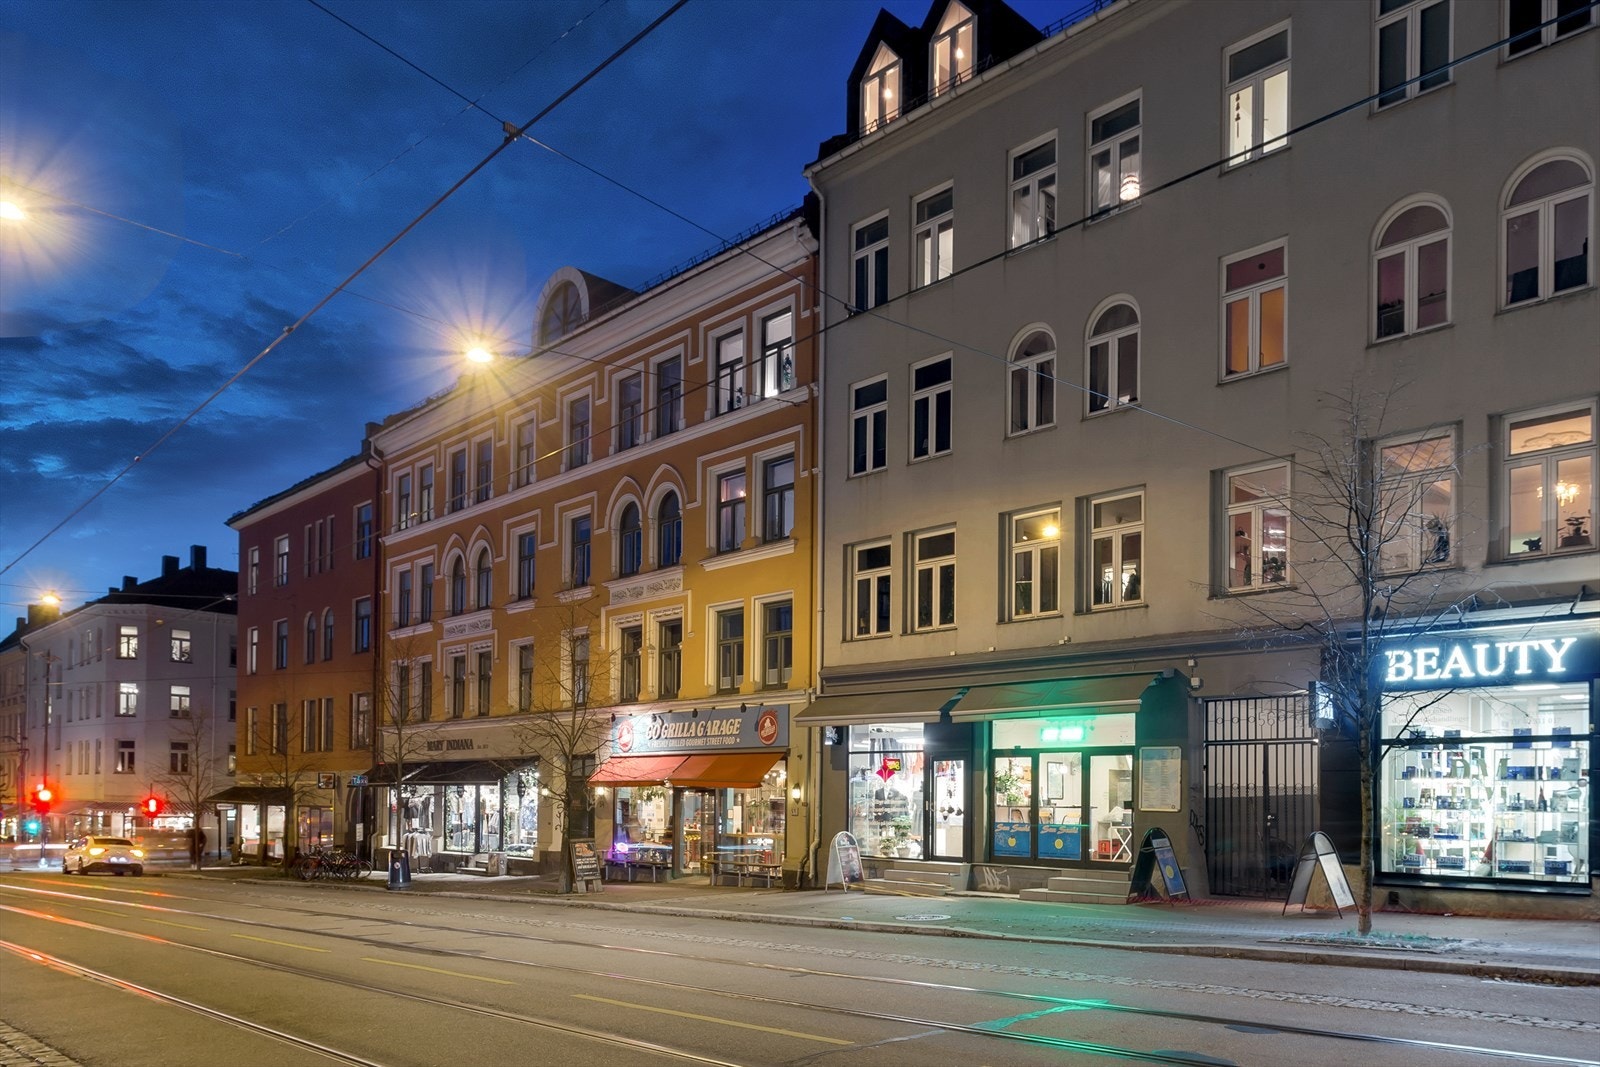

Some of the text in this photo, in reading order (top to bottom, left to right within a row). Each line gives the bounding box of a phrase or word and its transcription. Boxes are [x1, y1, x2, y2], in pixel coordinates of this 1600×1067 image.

[1385, 638, 1577, 682] BEAUTY
[661, 722, 695, 738] GRILLA
[697, 718, 742, 737] GARAGE
[446, 738, 474, 751] INDIANA
[668, 739, 686, 747] GRILLED
[686, 738, 706, 747] GOURMET
[706, 737, 722, 746] STREET
[722, 736, 736, 745] FOOD
